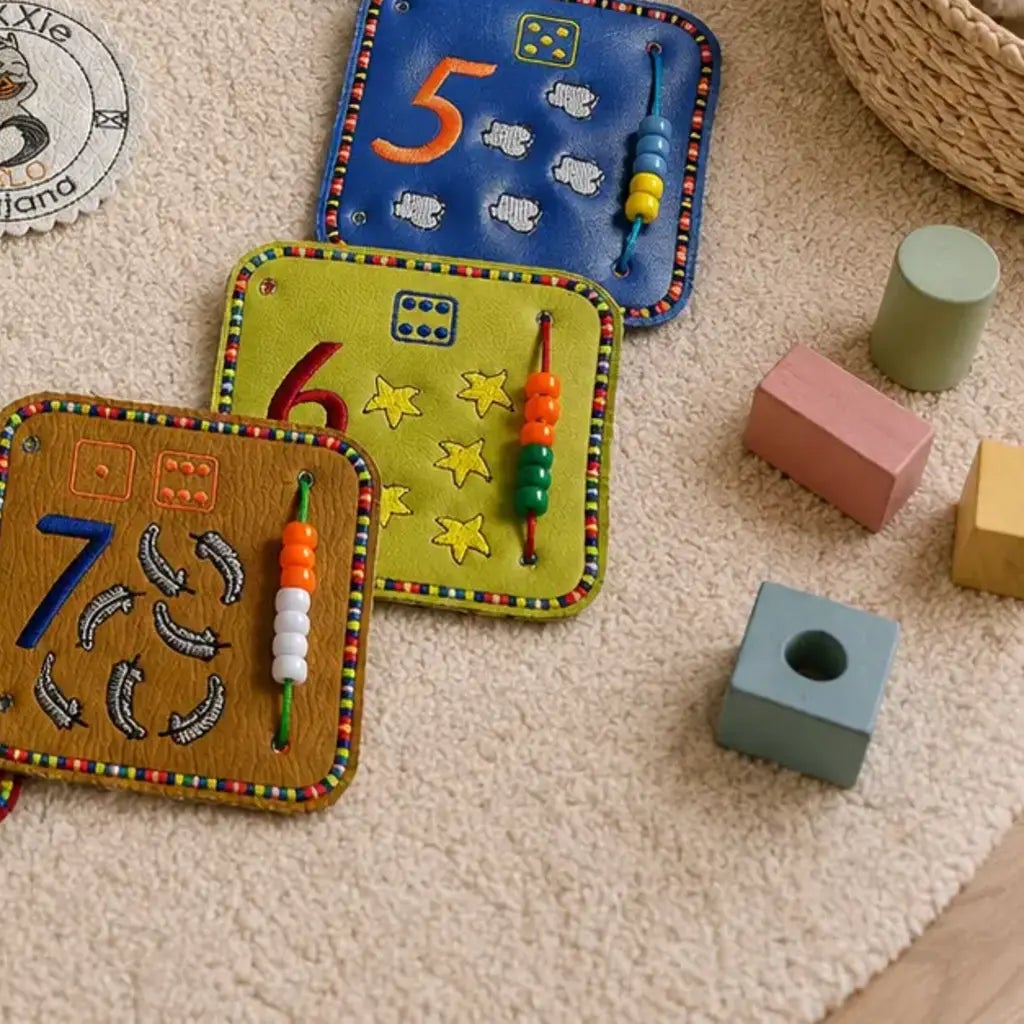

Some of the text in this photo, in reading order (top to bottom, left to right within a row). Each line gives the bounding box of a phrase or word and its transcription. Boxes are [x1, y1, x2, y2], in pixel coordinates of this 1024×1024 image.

[371, 56, 499, 164] 5
[267, 341, 349, 434] 6
[16, 513, 115, 649] 7
